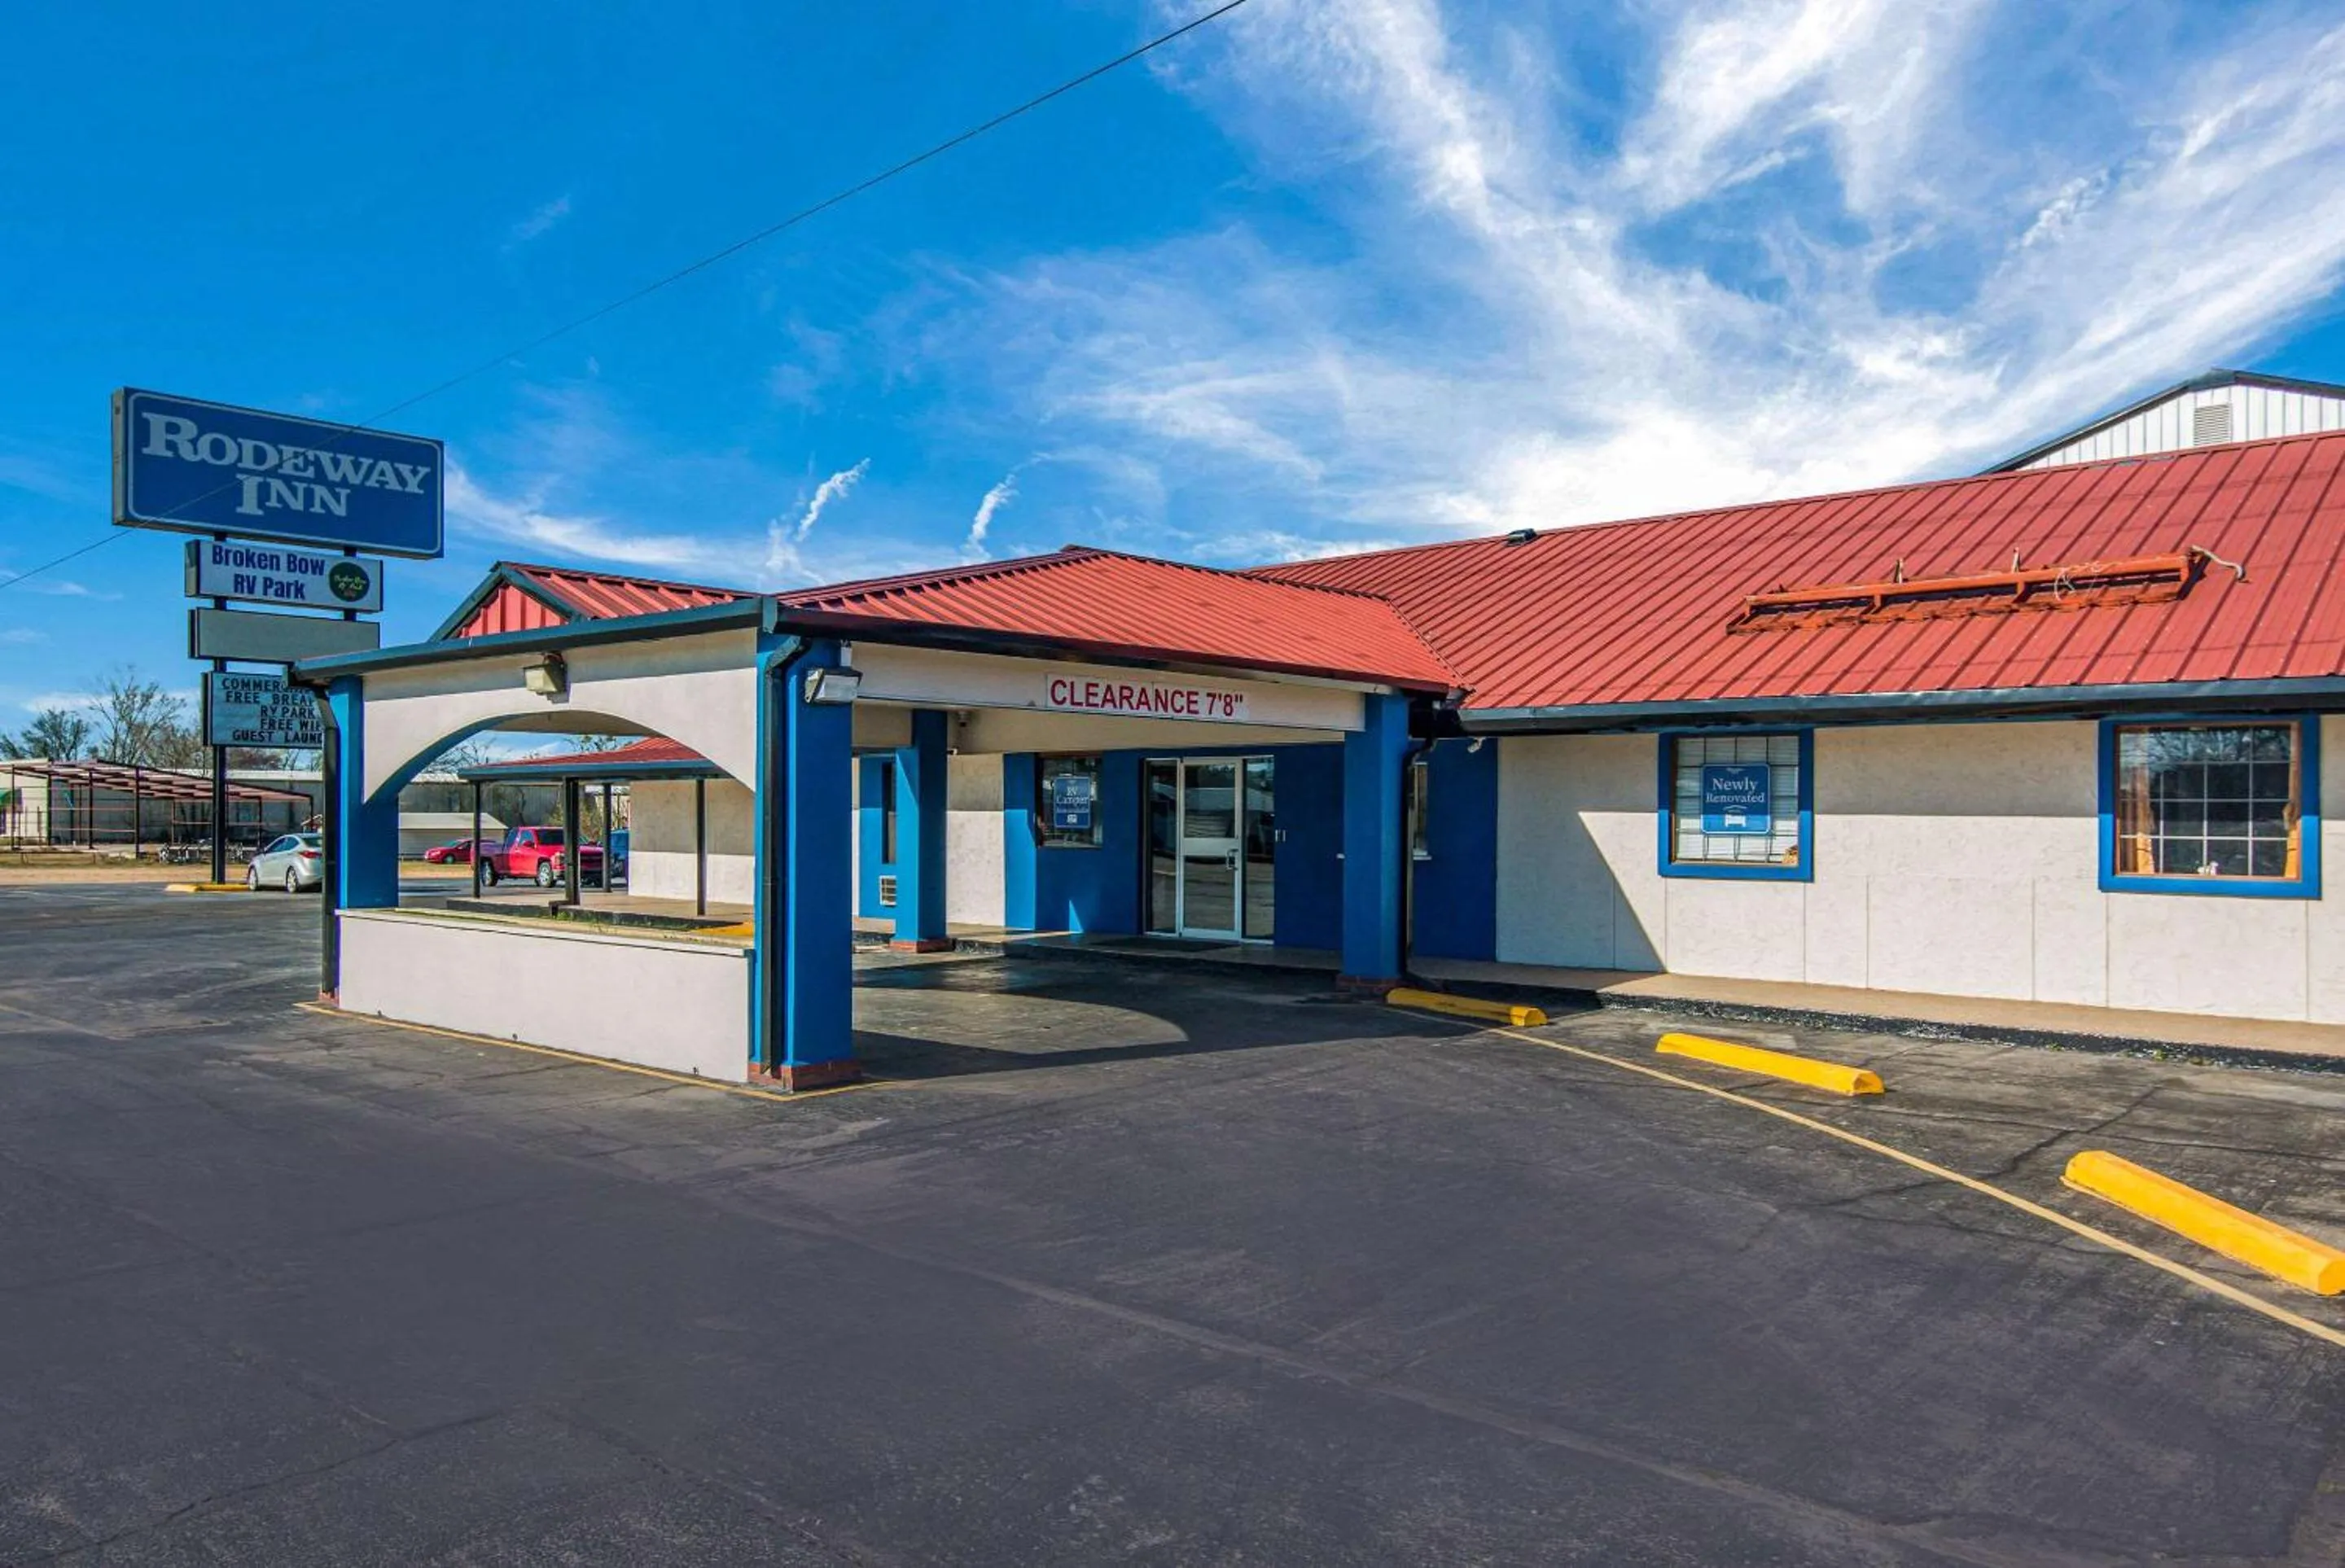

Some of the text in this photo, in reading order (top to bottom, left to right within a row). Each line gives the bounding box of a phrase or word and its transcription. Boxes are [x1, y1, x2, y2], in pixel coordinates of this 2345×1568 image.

[141, 412, 432, 494] RODEWAY
[235, 473, 351, 516] INN
[212, 545, 325, 576] Broken Bow
[234, 573, 305, 600] RV Park
[226, 690, 261, 704] FREE
[1050, 679, 1243, 716] CLEARANCE 7'8"
[261, 705, 315, 720] RV PARK
[261, 718, 293, 731] FREE
[232, 729, 274, 742] GUEST
[1712, 777, 1759, 795] Newly
[1706, 792, 1765, 804] Renovated
